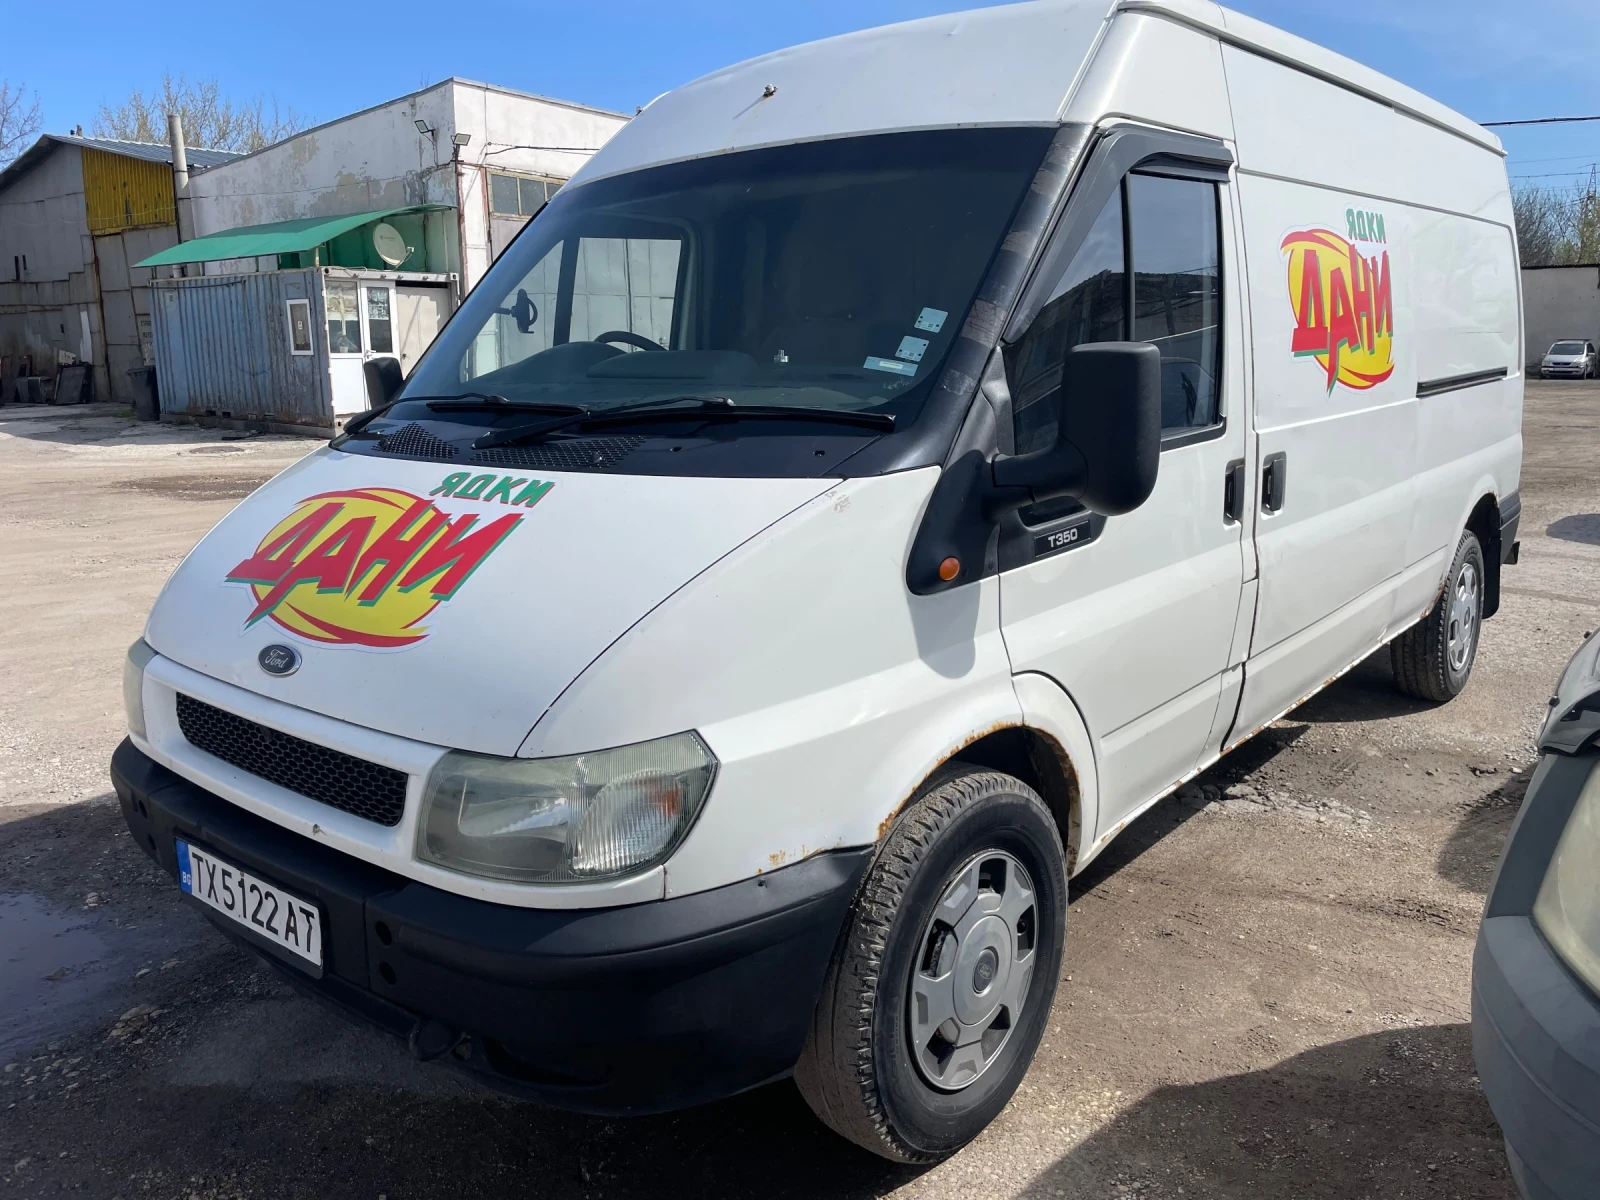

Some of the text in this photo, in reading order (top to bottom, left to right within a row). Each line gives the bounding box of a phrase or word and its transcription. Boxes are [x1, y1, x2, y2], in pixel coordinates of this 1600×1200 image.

[1346, 208, 1387, 244] ЯДКИ
[1291, 244, 1394, 399] ДАНИ
[429, 472, 555, 508] ЯДКИ
[1048, 527, 1078, 548] T350
[224, 499, 525, 631] ДАНИ
[265, 649, 289, 668] Ford
[182, 872, 192, 885] BG
